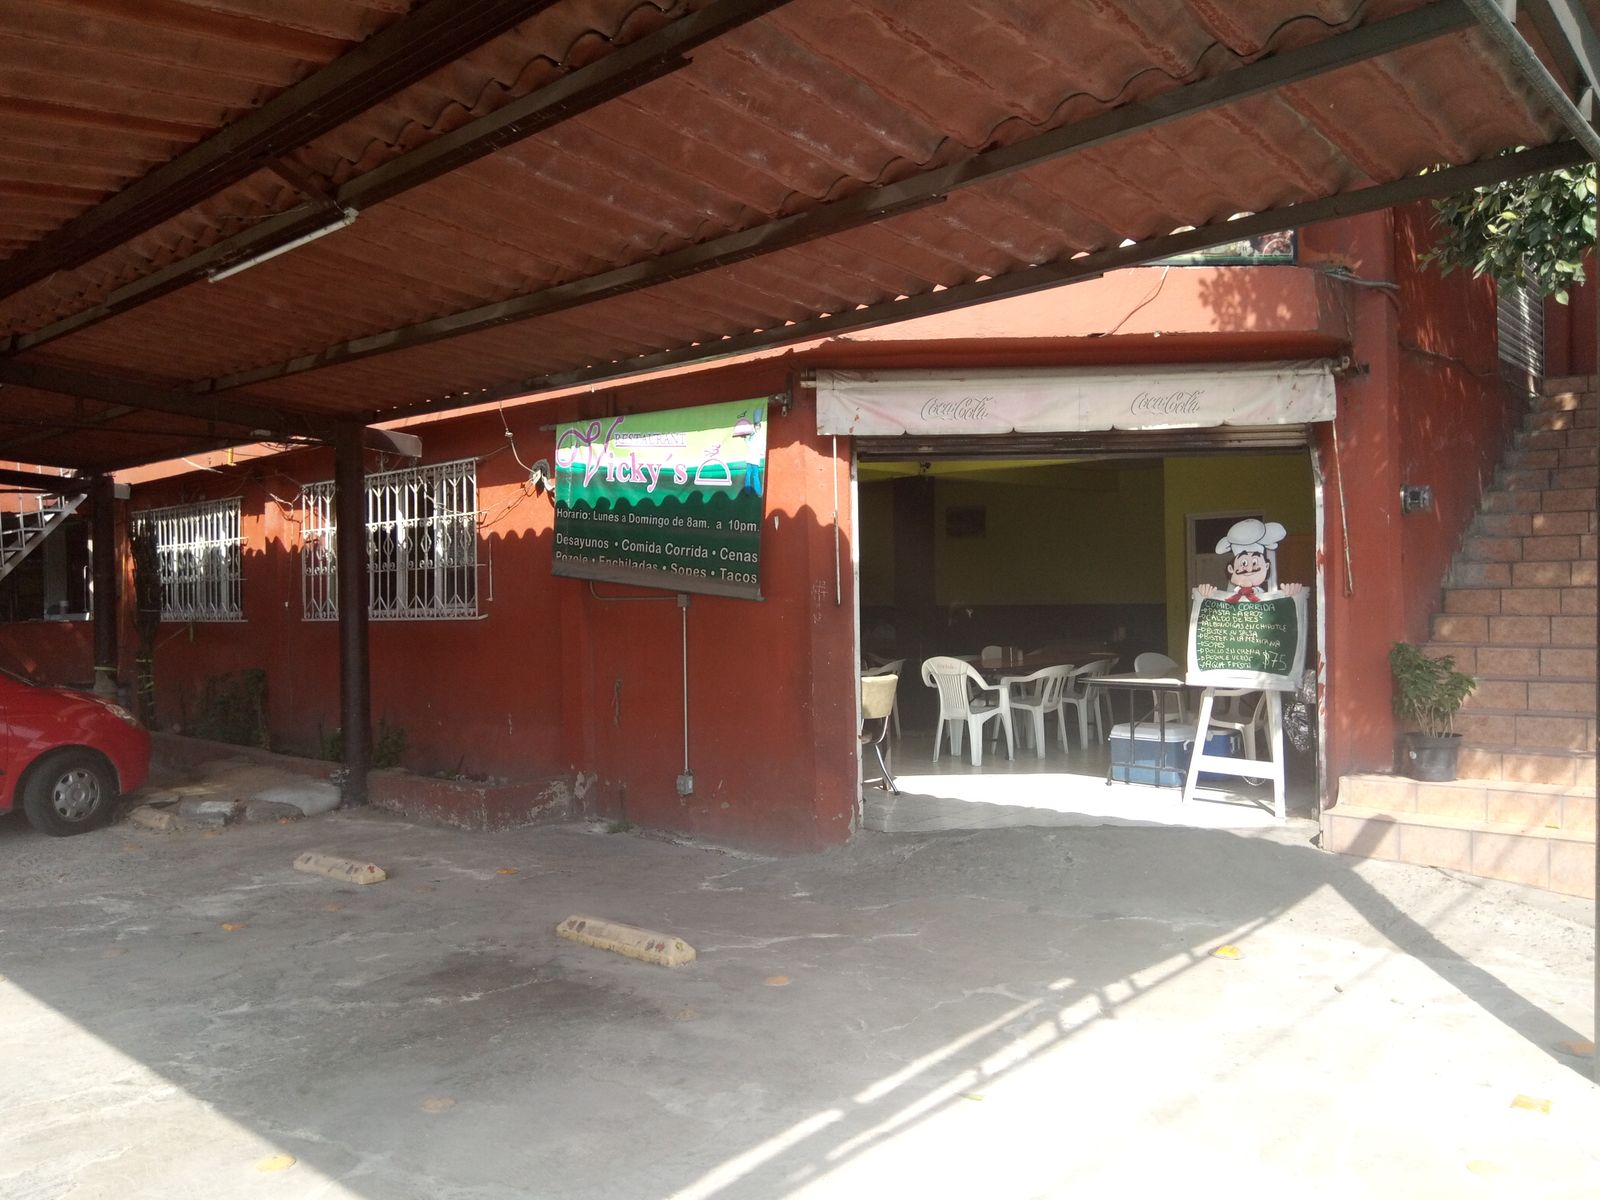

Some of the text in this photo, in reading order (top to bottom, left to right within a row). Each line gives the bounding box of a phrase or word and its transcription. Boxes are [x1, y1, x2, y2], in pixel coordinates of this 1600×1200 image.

[921, 396, 993, 421] Coca-Cola
[1130, 390, 1205, 415] Coca-Cola
[614, 432, 687, 446] RESTAURANT
[556, 508, 760, 533] Horario: Lunes a Domingo de 8am. a 10pm.
[556, 533, 759, 563] Desayunos Comida Corrida Cenas
[720, 568, 758, 584] Tacos
[1204, 600, 1276, 611] COMIDA CORRIDA
[1208, 608, 1230, 616] PASTA
[1206, 614, 1231, 622] CALDO
[1205, 660, 1225, 669] AGUA
[1262, 650, 1287, 671] $75
